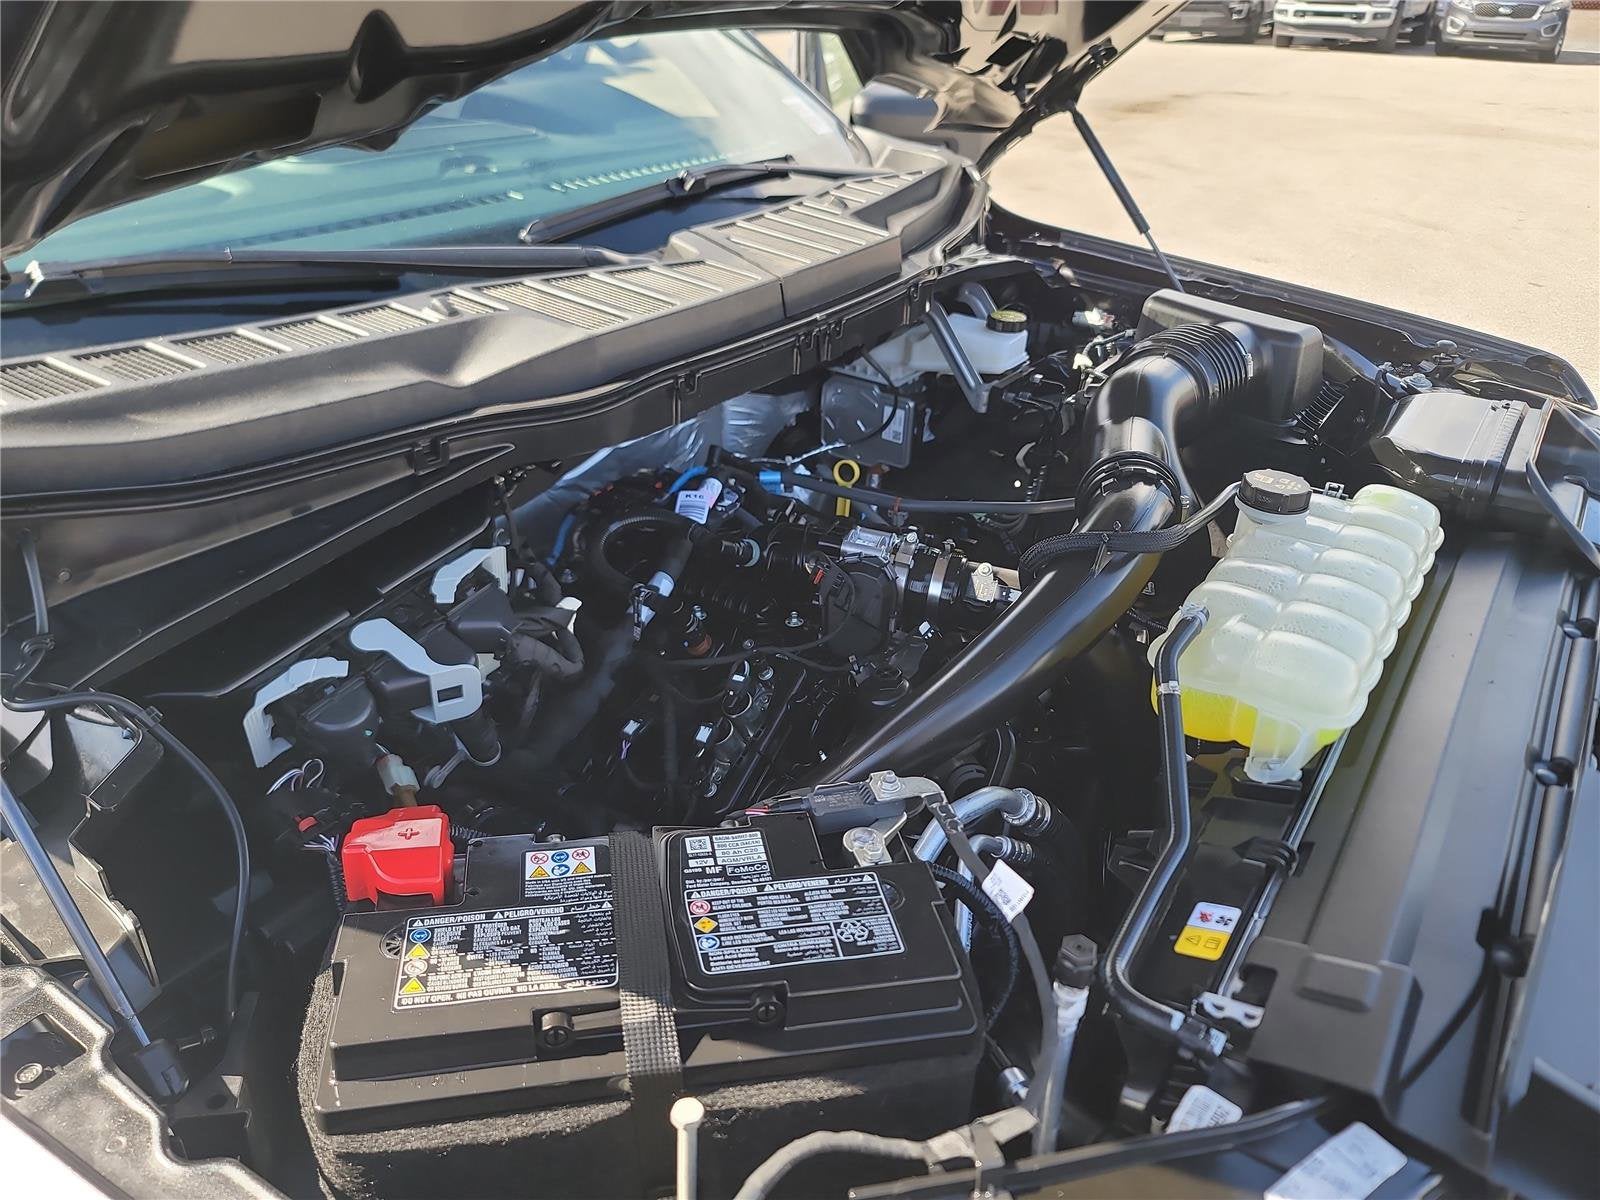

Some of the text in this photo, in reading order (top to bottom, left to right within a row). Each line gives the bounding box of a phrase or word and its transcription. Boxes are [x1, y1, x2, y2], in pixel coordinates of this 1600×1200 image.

[721, 855, 762, 863] AGM/VRLA
[706, 866, 722, 874] MF
[729, 864, 768, 874] FoMoCo
[774, 879, 829, 890] PELIGRO/VENENO
[701, 887, 758, 898] DANGER/POISON
[504, 906, 564, 918] PELIGRO/VENENO
[424, 914, 485, 926] DANGER/POISON
